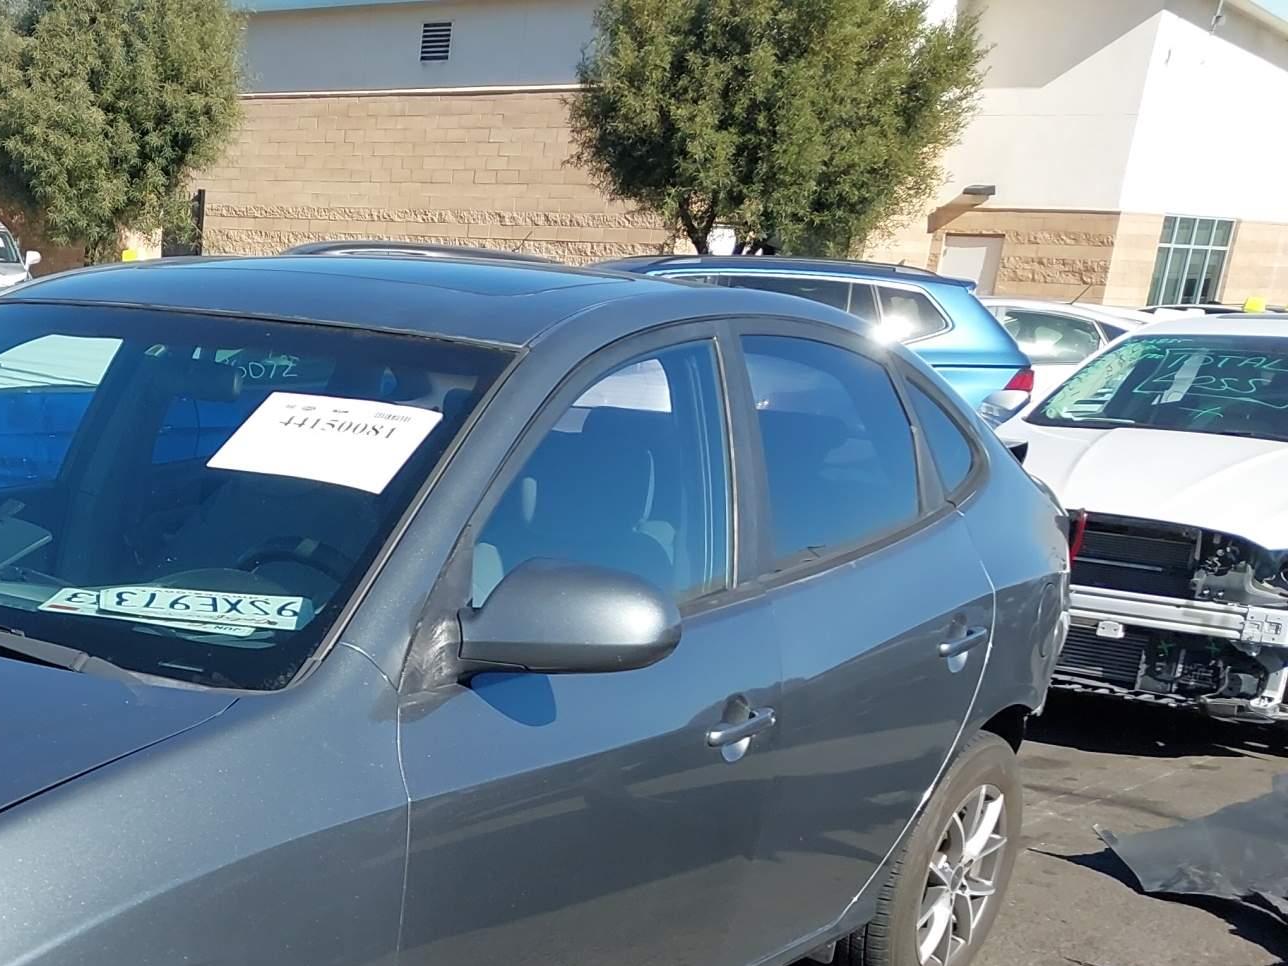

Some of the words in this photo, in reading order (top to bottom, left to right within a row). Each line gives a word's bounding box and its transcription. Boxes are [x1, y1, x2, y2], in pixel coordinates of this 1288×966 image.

[1168, 353, 1288, 371] TOTAL
[280, 415, 398, 439] 44150081
[115, 590, 299, 618] 9SXE973
